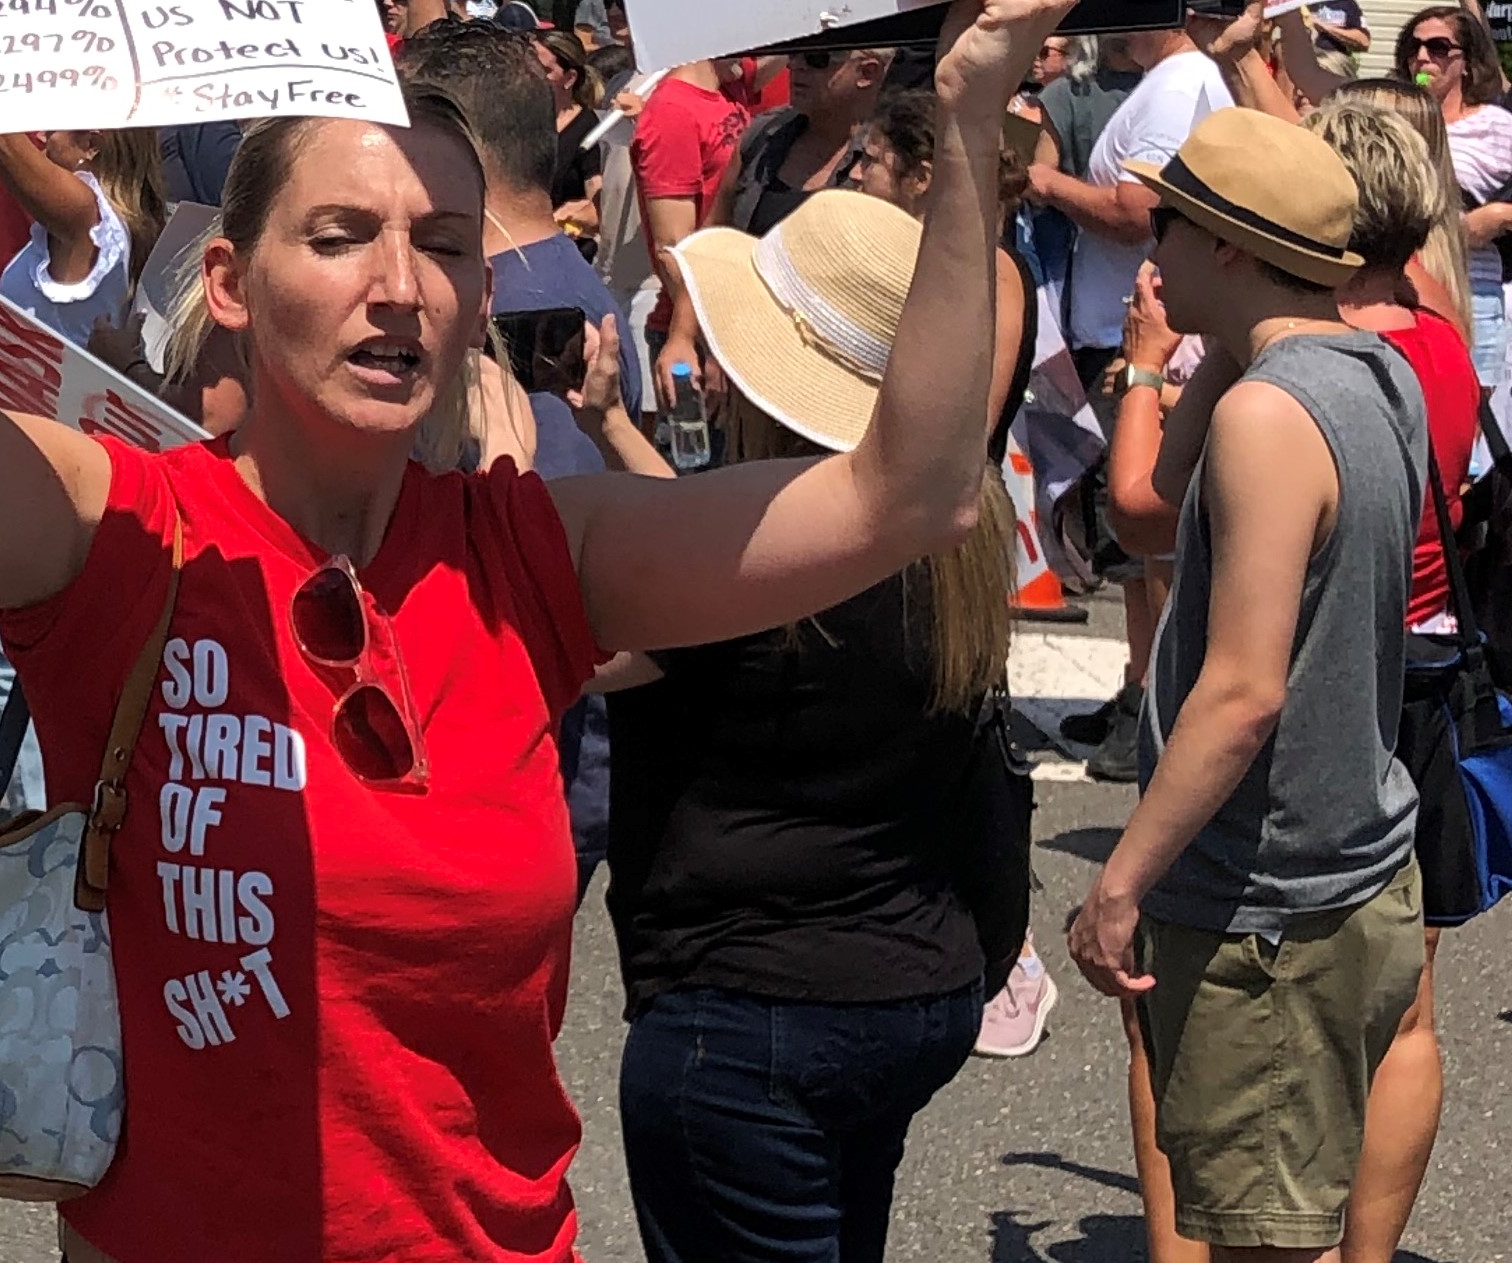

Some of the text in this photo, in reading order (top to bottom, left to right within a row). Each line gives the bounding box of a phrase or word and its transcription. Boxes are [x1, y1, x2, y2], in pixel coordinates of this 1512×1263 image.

[151, 39, 301, 67] Protect
[162, 637, 229, 709] SO
[159, 712, 306, 792] TIRED
[159, 782, 227, 856] OF
[157, 861, 274, 945] THIS
